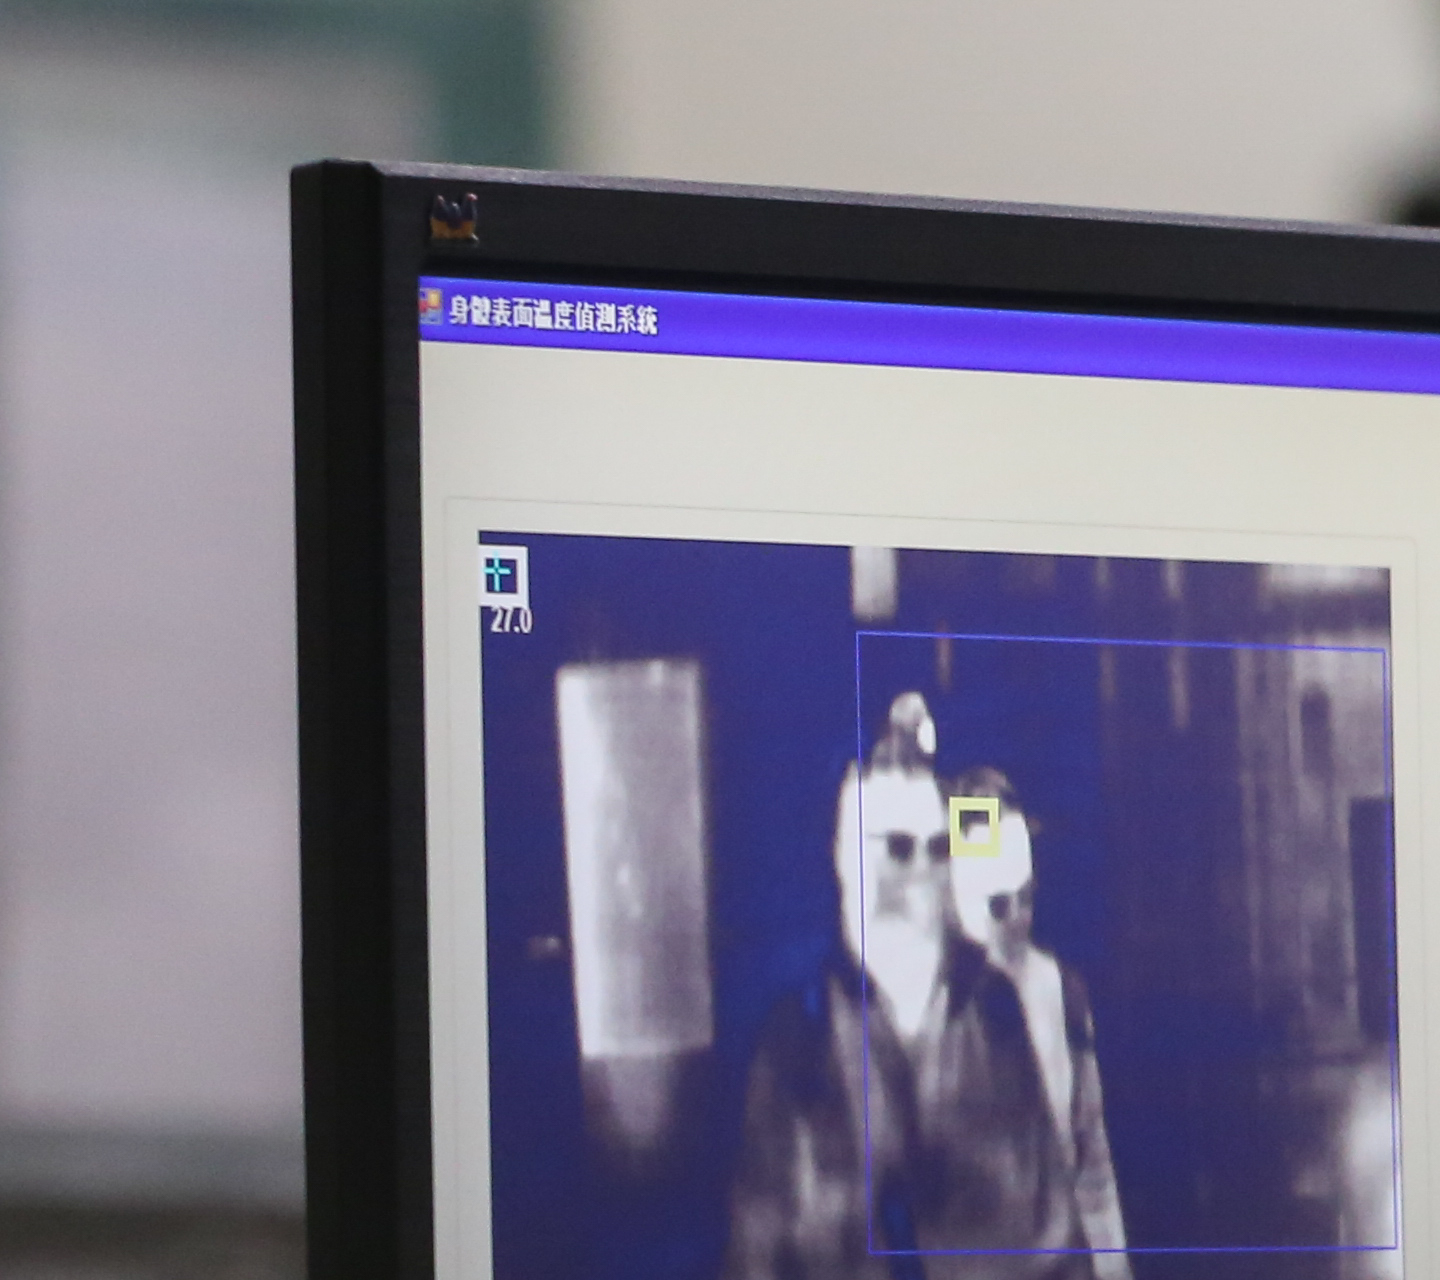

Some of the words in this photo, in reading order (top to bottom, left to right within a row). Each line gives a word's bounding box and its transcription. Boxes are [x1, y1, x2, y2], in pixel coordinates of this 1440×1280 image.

[449, 294, 659, 336] 身體表面溫度偵測系統
